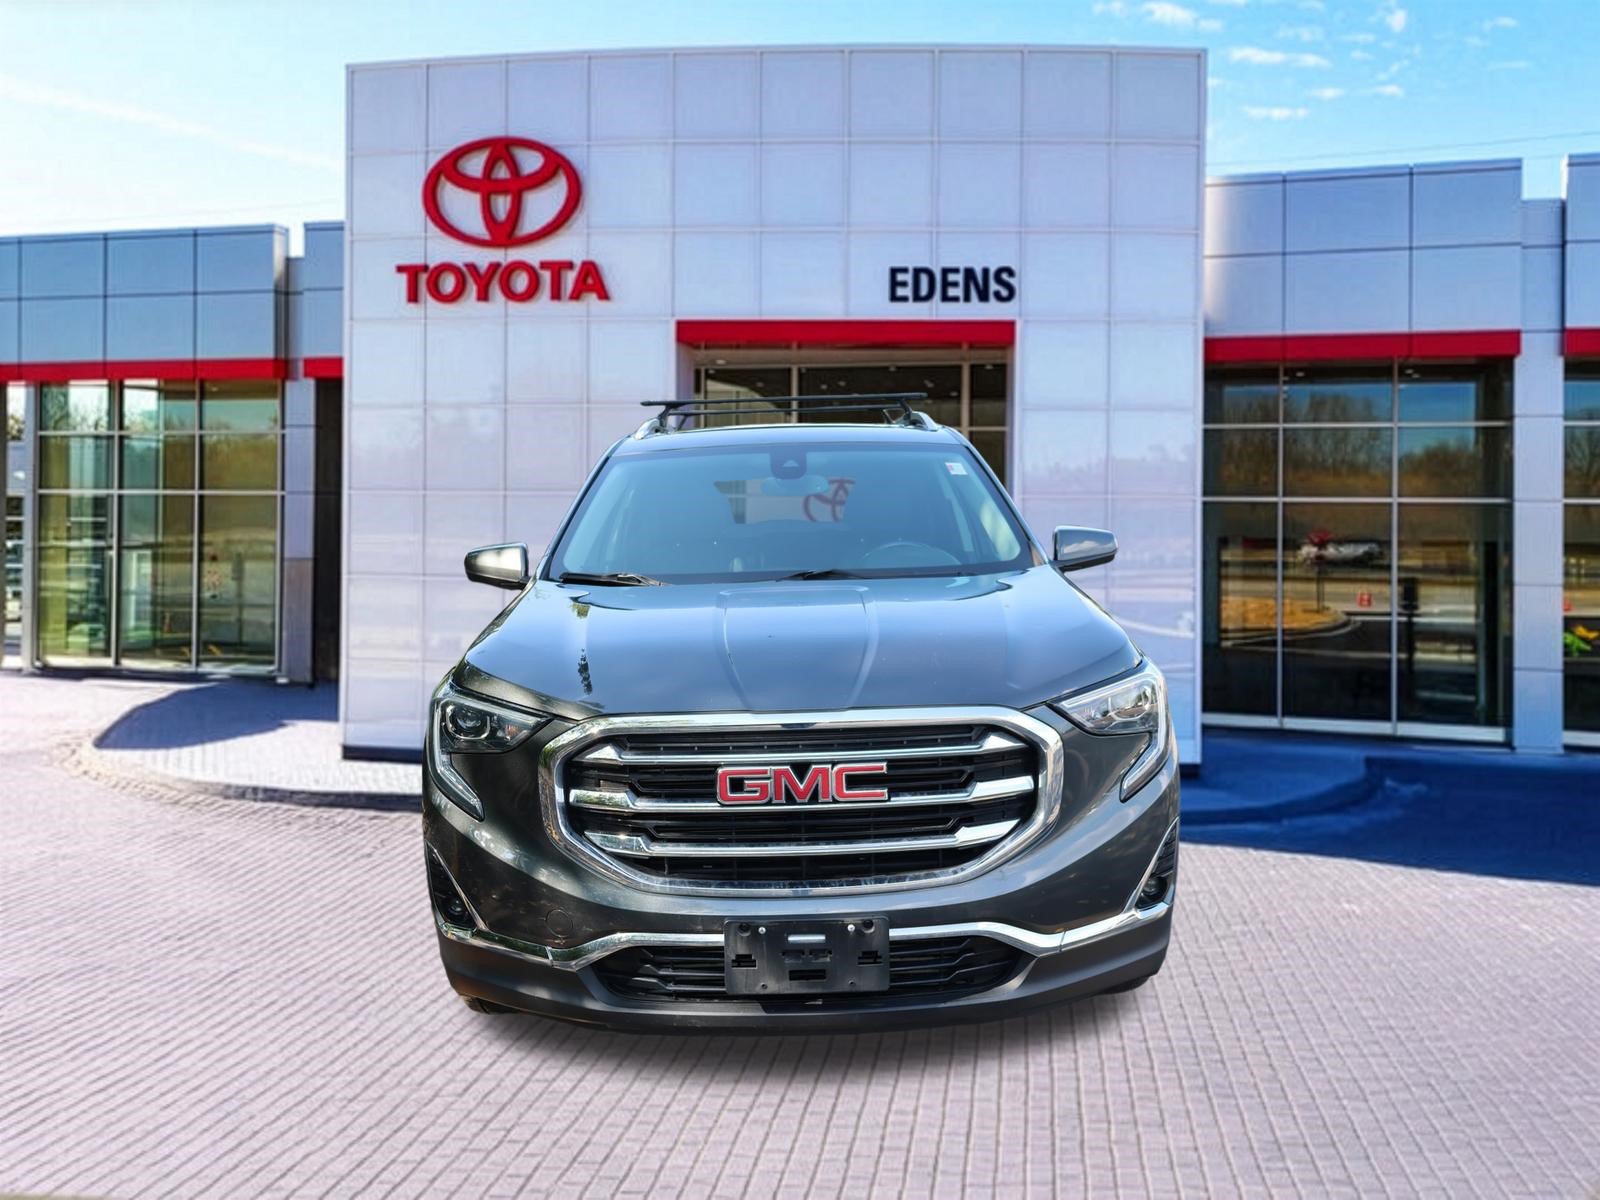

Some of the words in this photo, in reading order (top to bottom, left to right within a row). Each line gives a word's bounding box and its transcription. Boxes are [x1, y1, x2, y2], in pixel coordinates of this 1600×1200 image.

[397, 260, 610, 304] TOYOTA
[889, 266, 1016, 303] EDENS
[716, 762, 888, 804] GMC
